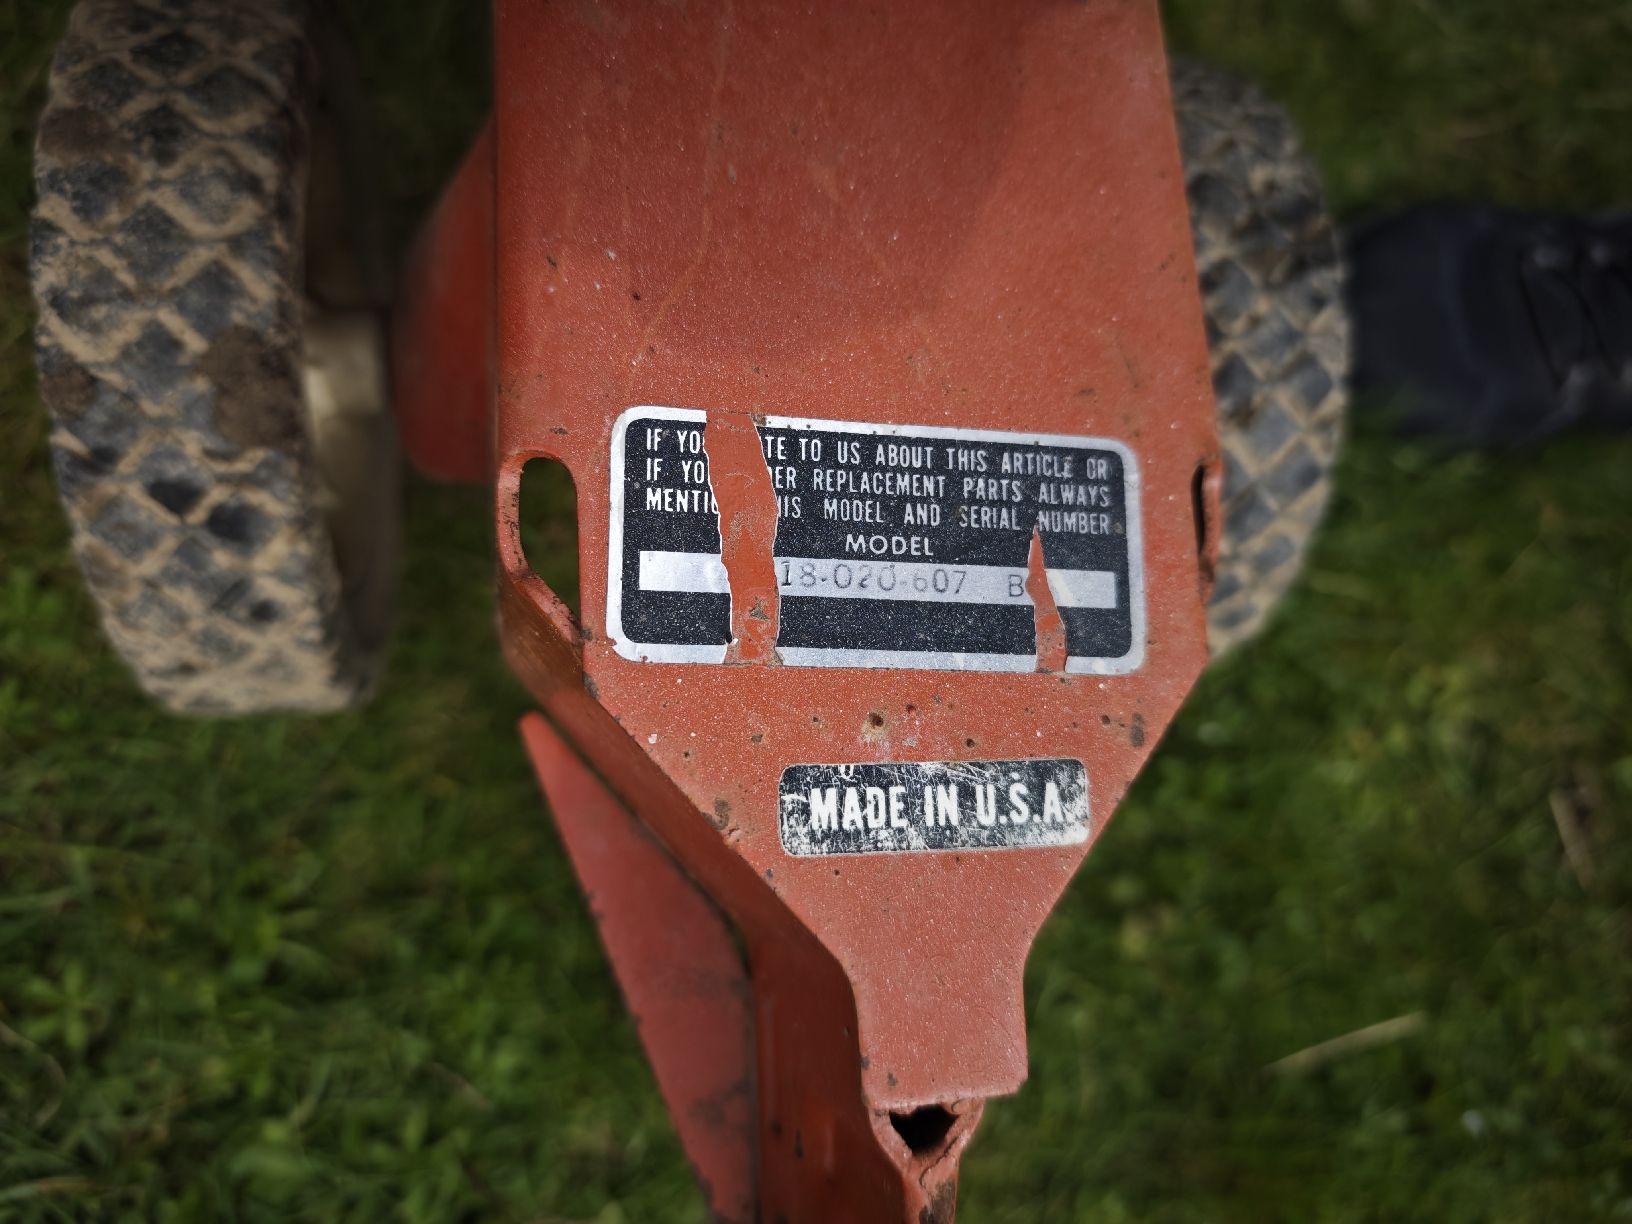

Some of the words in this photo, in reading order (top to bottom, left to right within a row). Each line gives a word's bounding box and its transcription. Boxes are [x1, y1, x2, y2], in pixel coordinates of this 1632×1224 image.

[646, 428, 662, 452] IF
[677, 430, 701, 454] YO
[798, 438, 822, 462] TO
[837, 441, 861, 465] US
[875, 444, 934, 470] ABOUT
[945, 448, 988, 473] THIS
[1001, 452, 1074, 480] ARTICLE
[1086, 458, 1109, 481] OR
[646, 458, 664, 482] IF
[681, 460, 706, 484] YO
[813, 468, 946, 498] REPLACEMENT
[963, 477, 1022, 503] PARTS
[1038, 482, 1111, 508] ALWAYS
[646, 487, 720, 515] MENTI
[823, 498, 885, 524] MODEL
[904, 502, 941, 527] AND
[958, 505, 1022, 532] SERIAL
[1037, 509, 1110, 536] NUMBER
[844, 533, 934, 557] MODEL
[1008, 574, 1025, 598] B
[810, 786, 908, 831] MADE
[924, 785, 958, 827] IN
